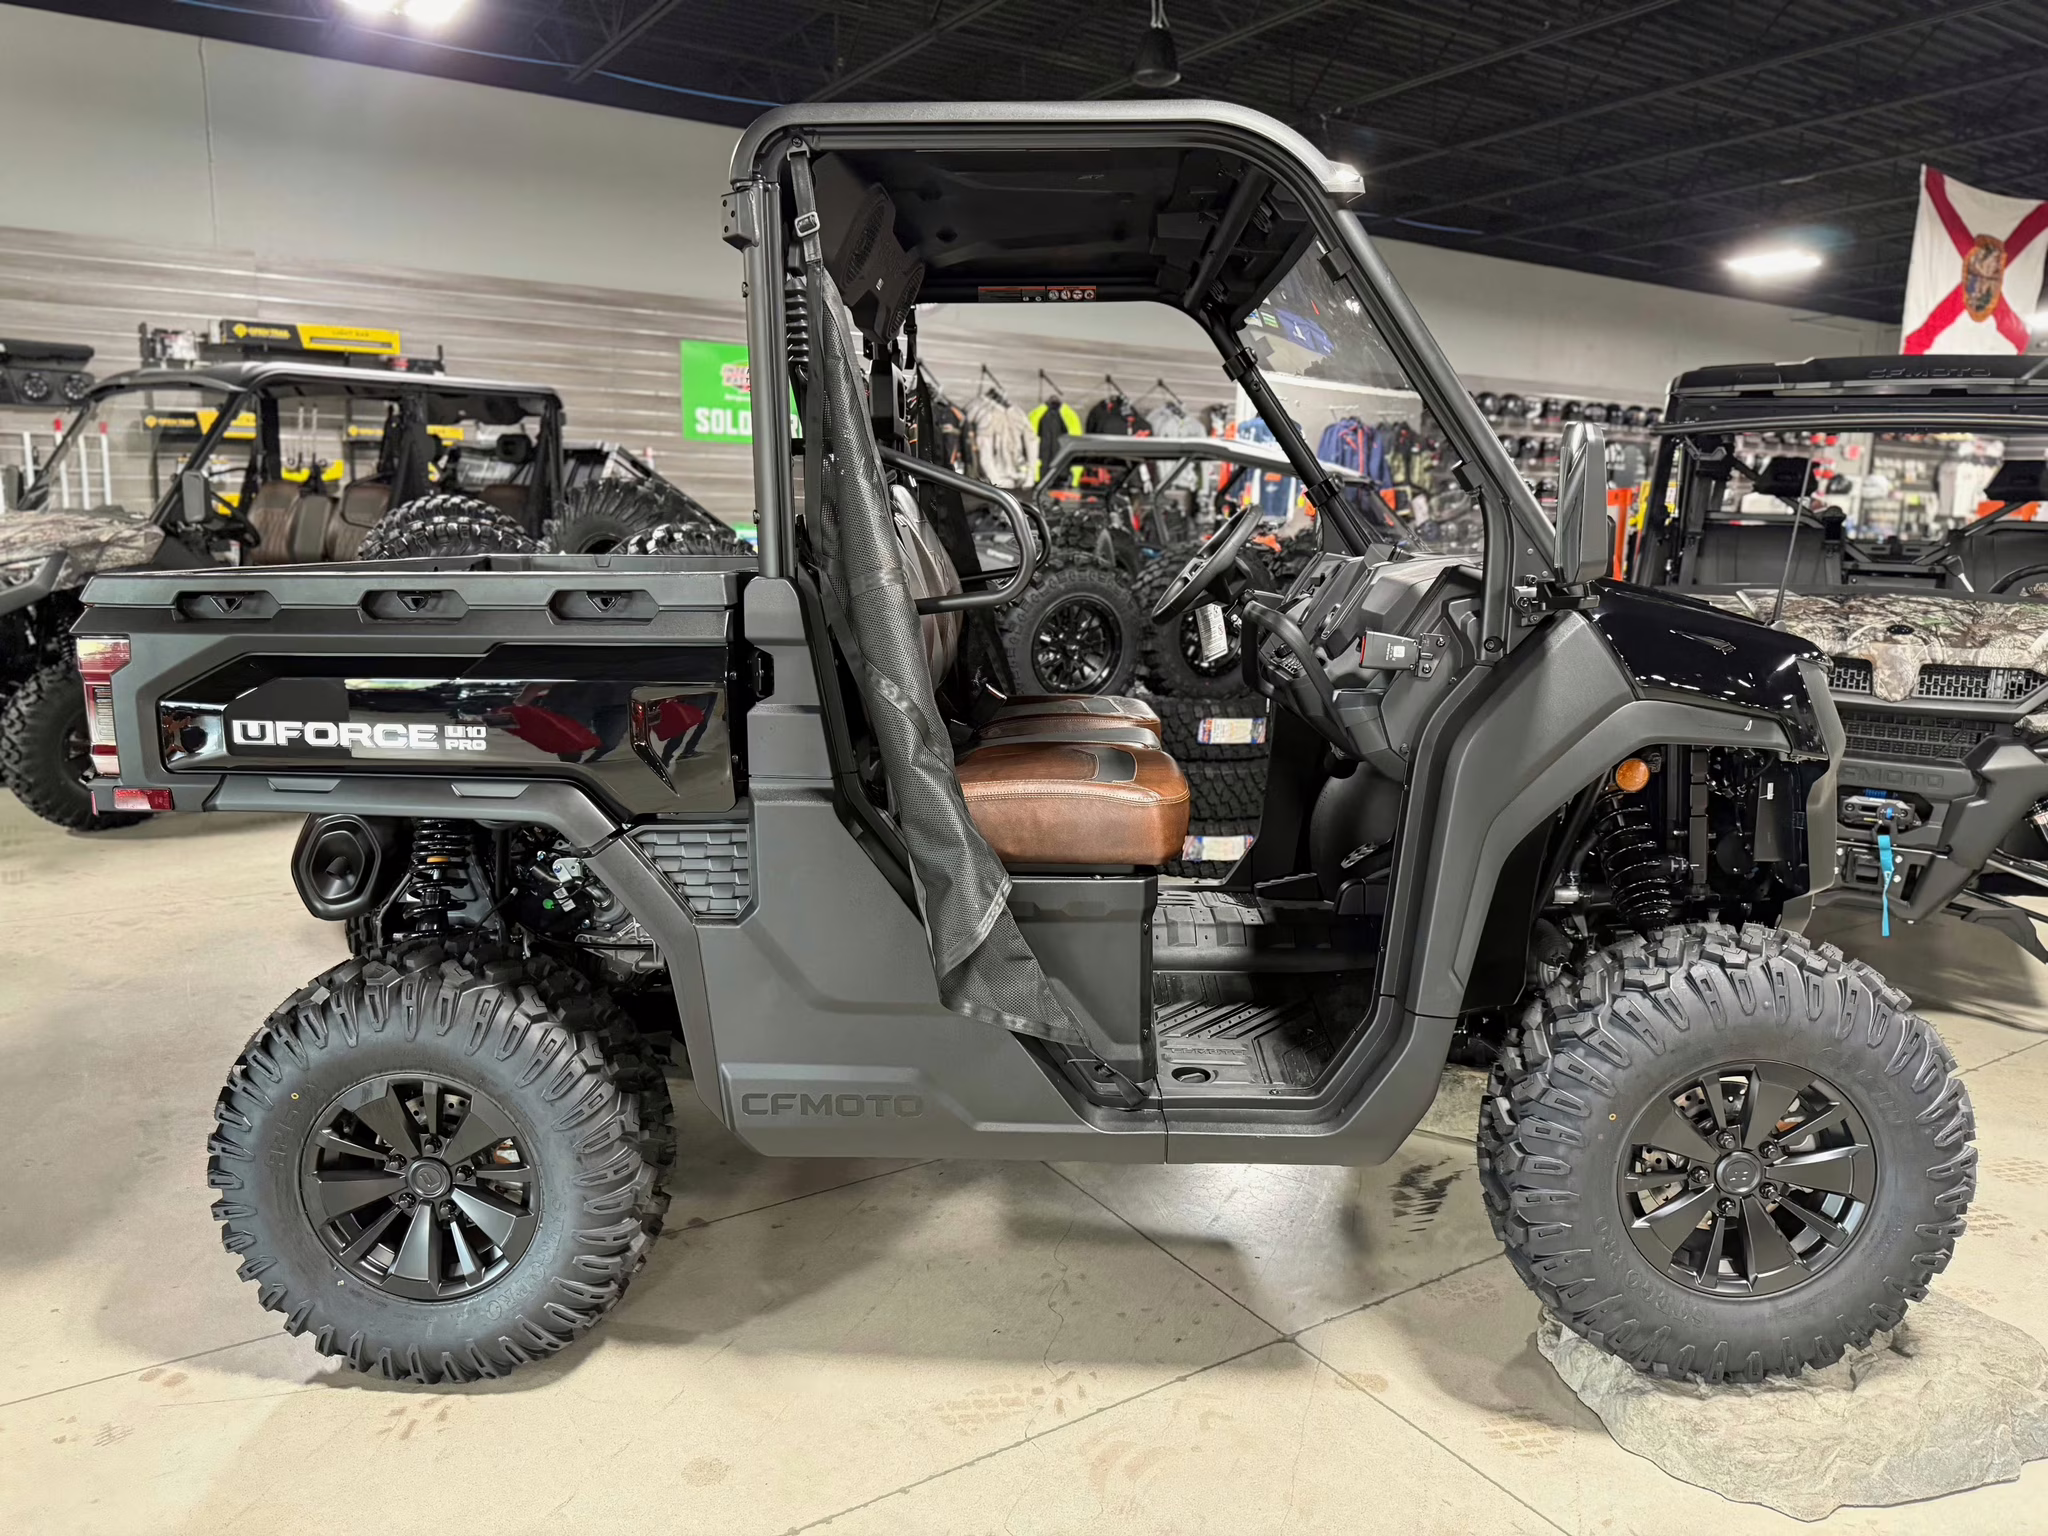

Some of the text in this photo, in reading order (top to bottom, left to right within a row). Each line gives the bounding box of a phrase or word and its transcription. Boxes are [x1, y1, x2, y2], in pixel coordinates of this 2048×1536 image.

[1867, 367, 1992, 379] CFMOTO
[232, 720, 439, 750] UFORCE
[444, 739, 487, 751] PRO
[1841, 765, 1945, 789] FMOTO
[741, 1093, 924, 1118] CFMOTO
